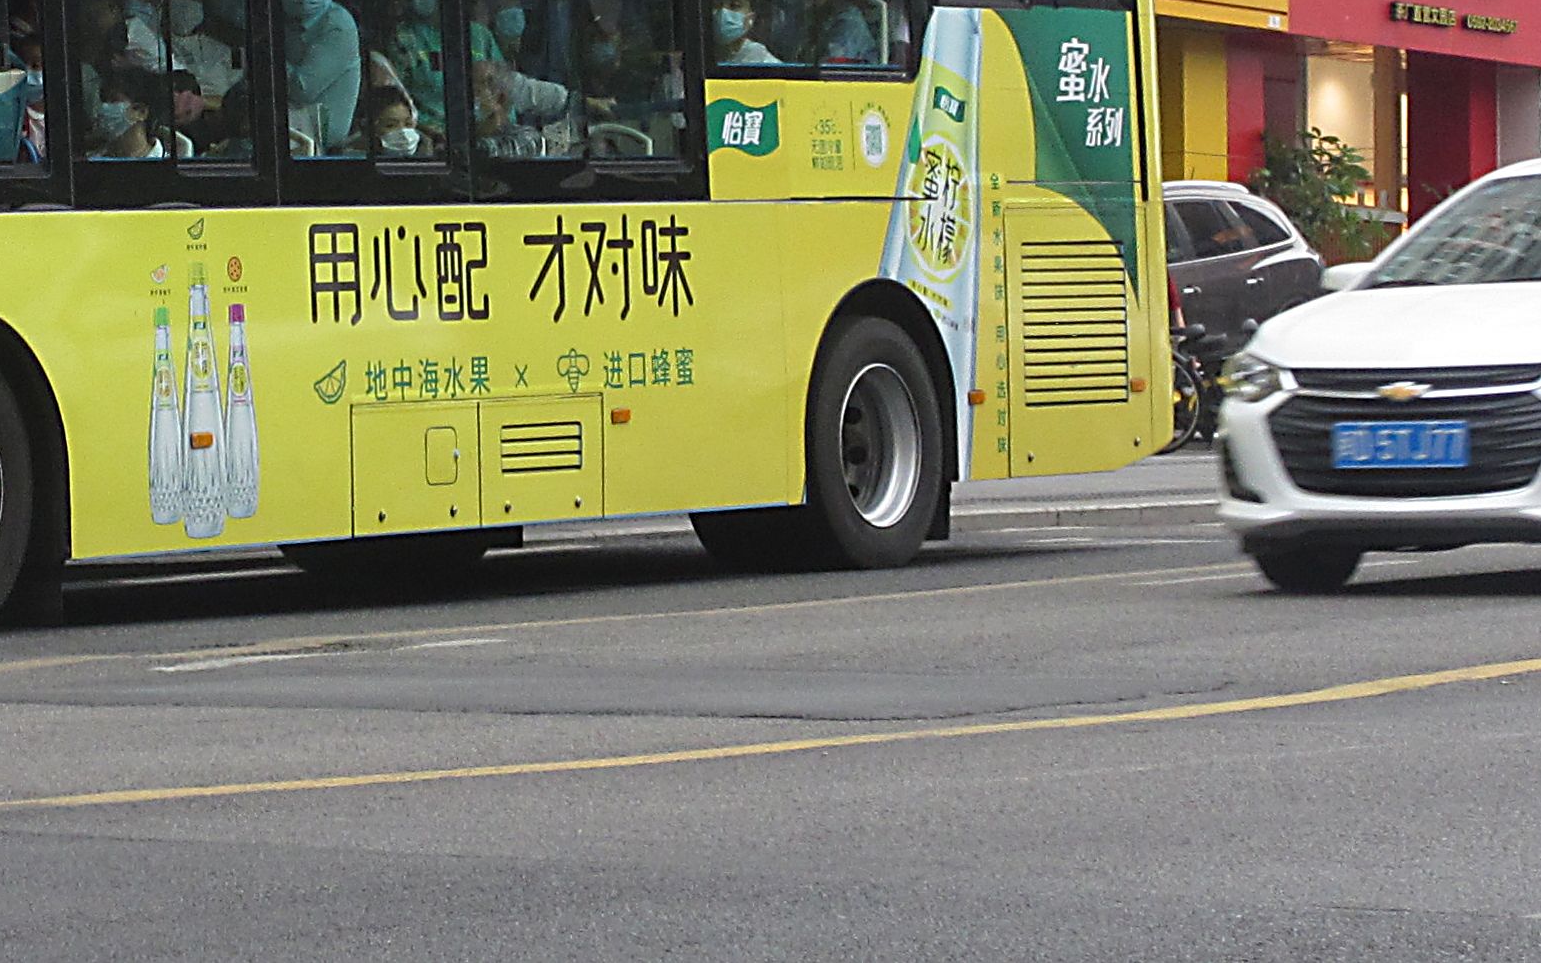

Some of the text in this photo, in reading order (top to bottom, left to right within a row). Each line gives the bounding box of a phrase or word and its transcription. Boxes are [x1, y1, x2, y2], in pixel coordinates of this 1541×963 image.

[1056, 37, 1111, 103] 蜜水
[1085, 106, 1124, 147] 系列
[309, 213, 694, 326] 用心配 才对味
[363, 355, 491, 402] 地中海水果
[603, 347, 695, 390] 进口蜂蜜
